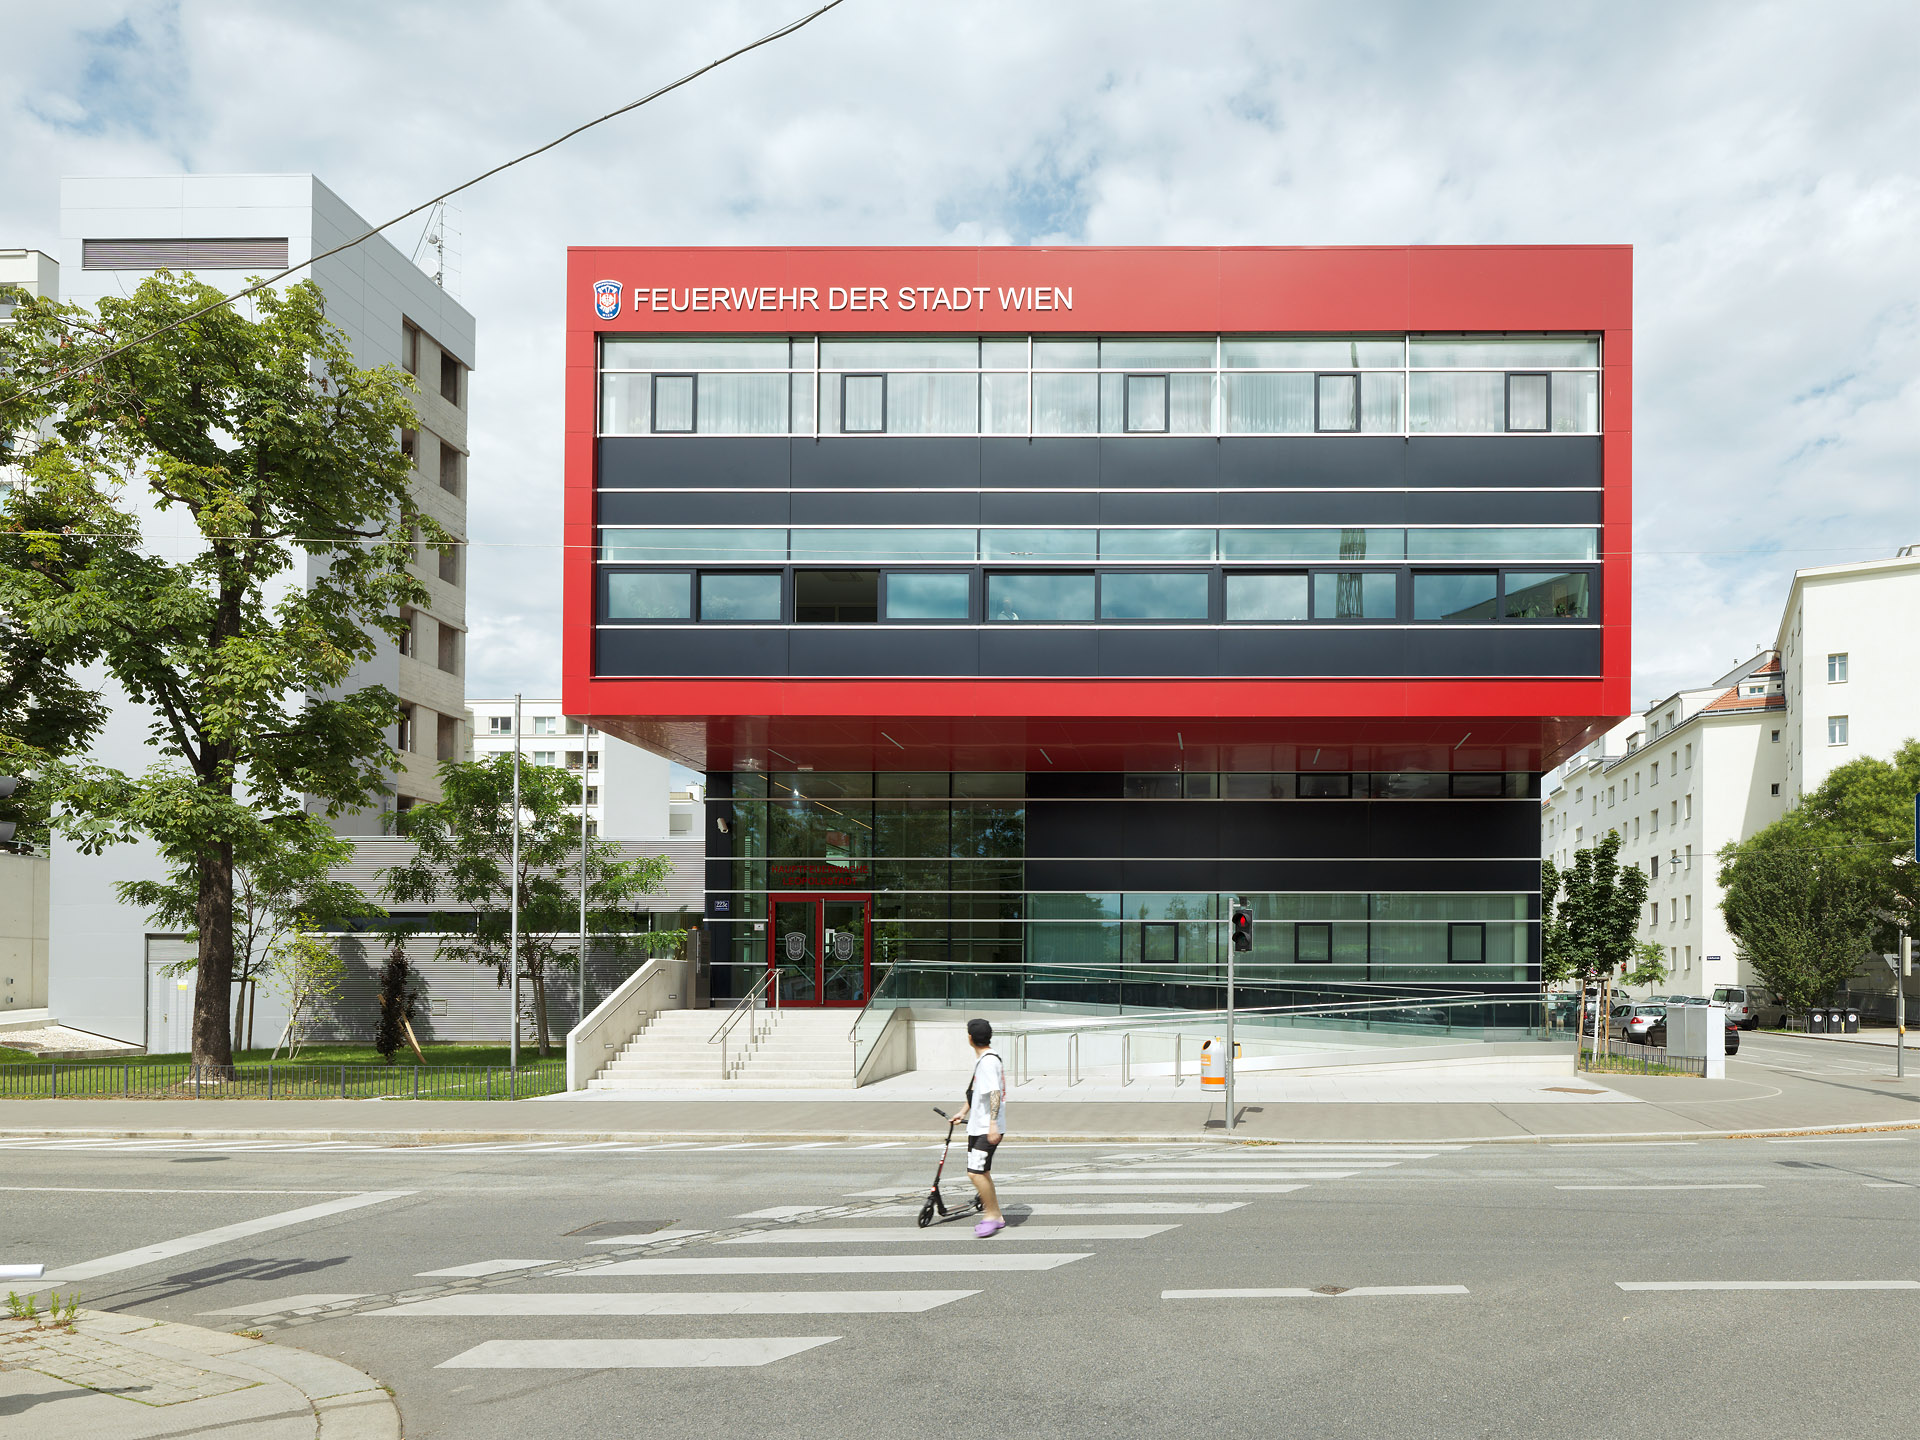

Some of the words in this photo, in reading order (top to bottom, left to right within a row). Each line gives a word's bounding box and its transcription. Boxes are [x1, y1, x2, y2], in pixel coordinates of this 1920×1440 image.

[634, 288, 820, 310] FEUERWEHR
[829, 288, 889, 310] DER
[897, 287, 991, 310] STADT
[997, 287, 1073, 310] WIEN
[771, 865, 869, 874] HAUPTFEUERWACHE
[782, 877, 858, 886] LEOPOLDSTADT
